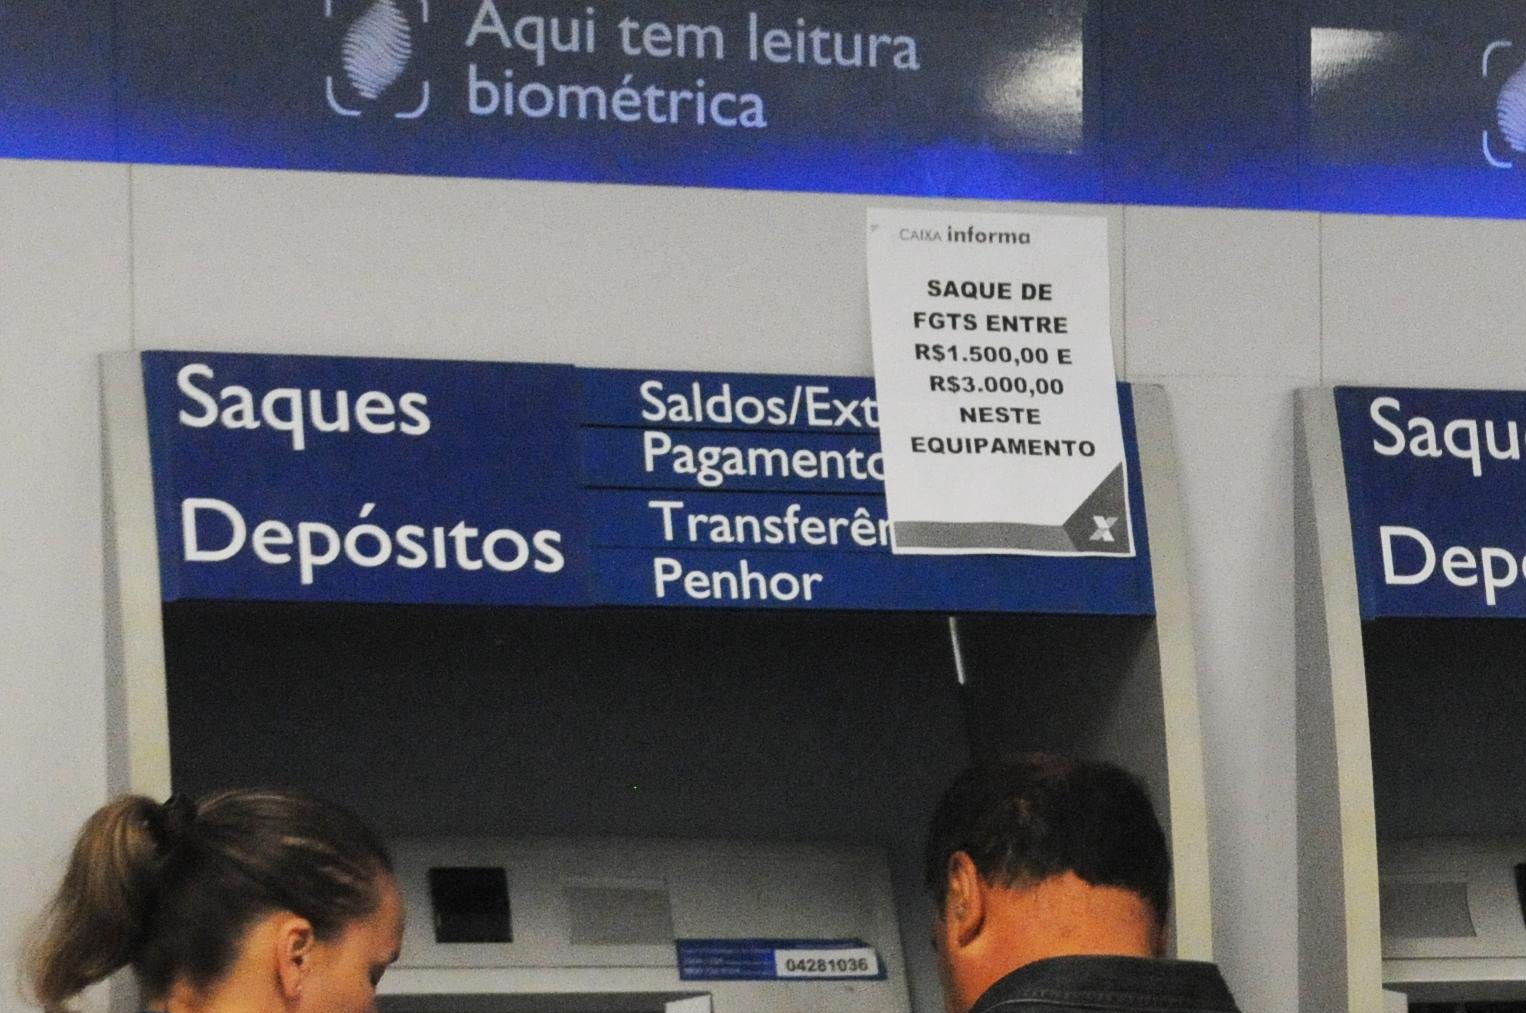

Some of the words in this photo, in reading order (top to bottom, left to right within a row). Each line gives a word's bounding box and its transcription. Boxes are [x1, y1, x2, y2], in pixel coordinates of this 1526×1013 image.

[465, 0, 596, 66] Aqui
[618, 15, 724, 59] tem
[749, 12, 920, 71] leitura
[468, 64, 768, 128] biométrica
[900, 228, 942, 242] CAIXA
[947, 226, 1031, 245] informa
[927, 280, 1012, 300] SAQUE
[1021, 283, 1053, 301] DE
[913, 312, 977, 331] FGTS
[986, 315, 1068, 334] ENTRE
[914, 344, 1049, 367] R$1.500,00
[1058, 349, 1073, 365] E
[929, 375, 1064, 398] R$3.000,00
[176, 363, 431, 451] Saques
[640, 380, 880, 428] Saldos/Ext
[960, 407, 1042, 425] NESTE
[910, 436, 1096, 457] EQUIPAMENTO
[181, 497, 565, 585] Depósitos
[654, 557, 823, 601] Penhor
[786, 958, 869, 973] 04281036
